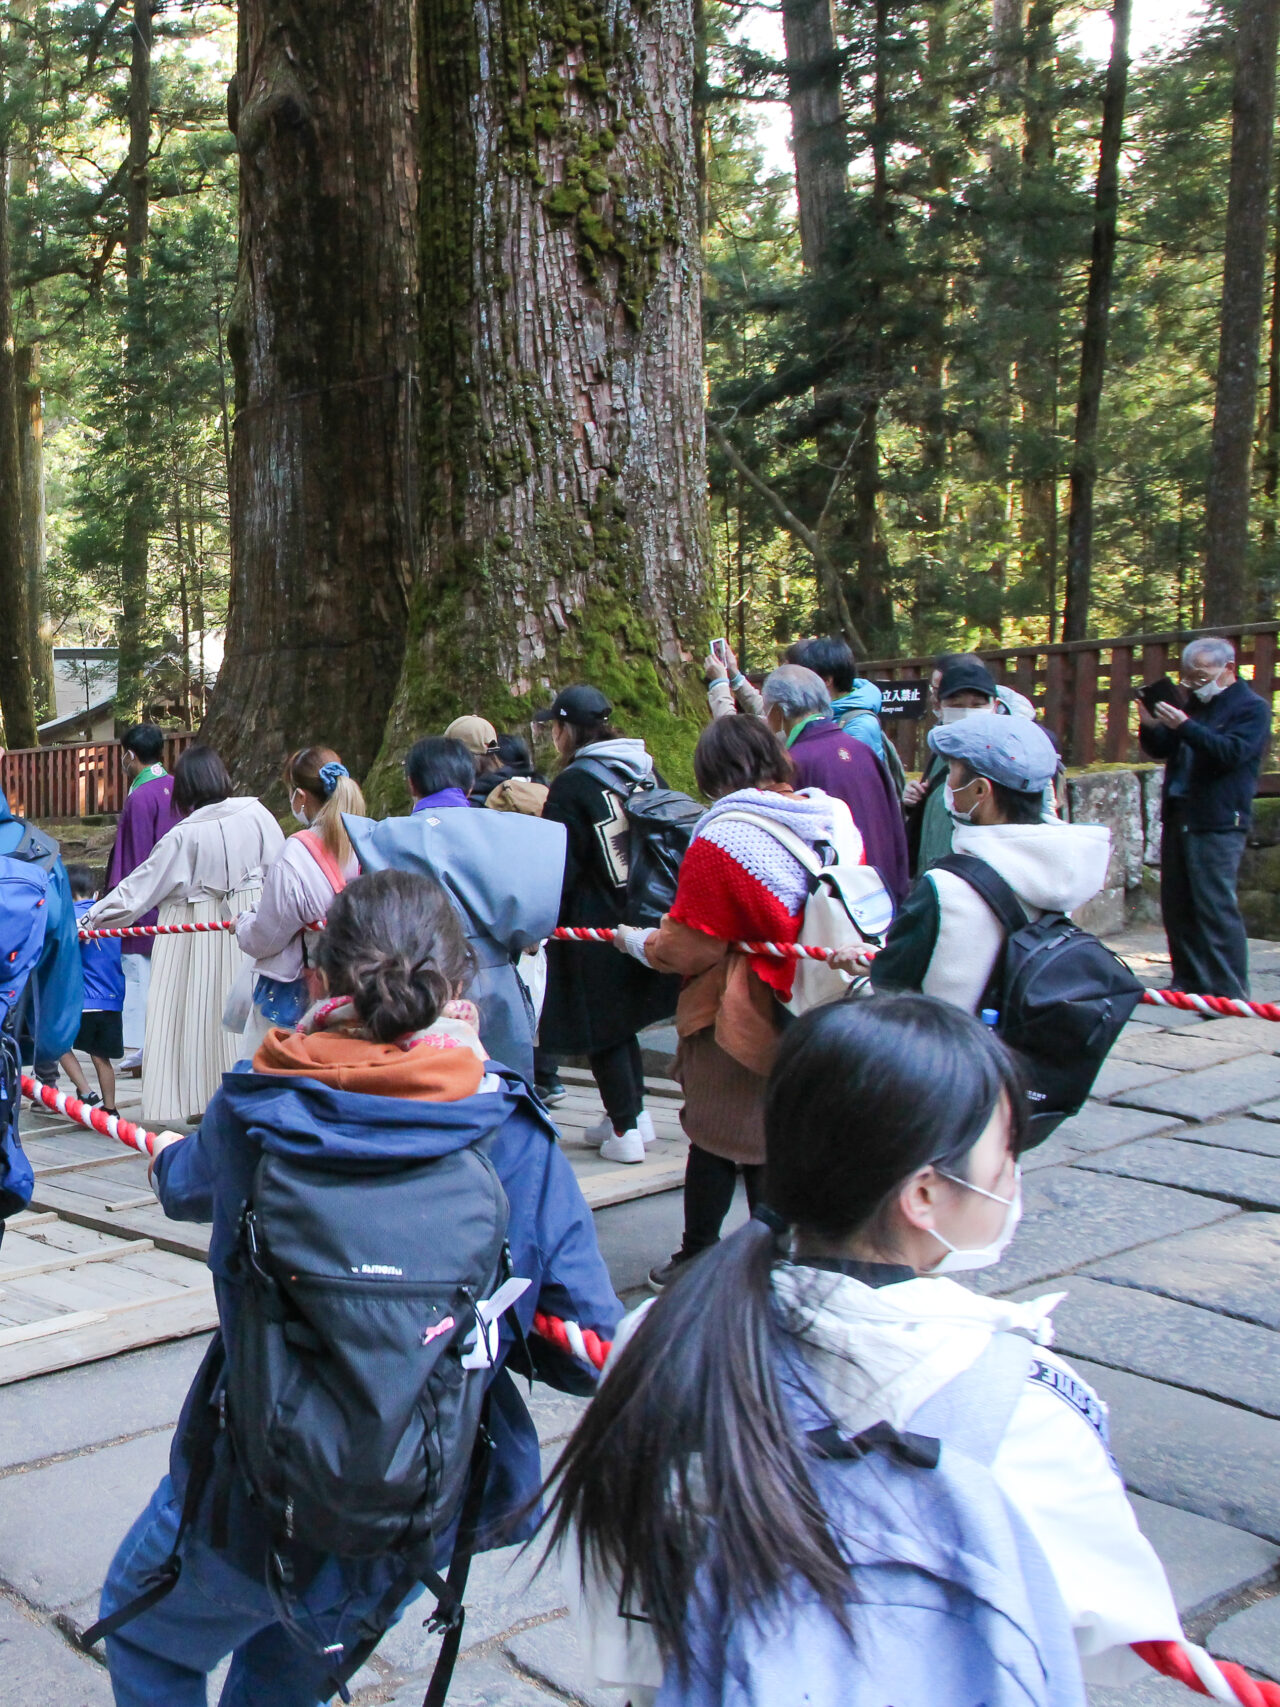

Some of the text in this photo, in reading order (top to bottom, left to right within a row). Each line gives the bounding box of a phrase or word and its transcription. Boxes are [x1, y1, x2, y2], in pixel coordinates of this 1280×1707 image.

[881, 688, 921, 702] 立入禁止
[881, 706, 895, 714] Keep
